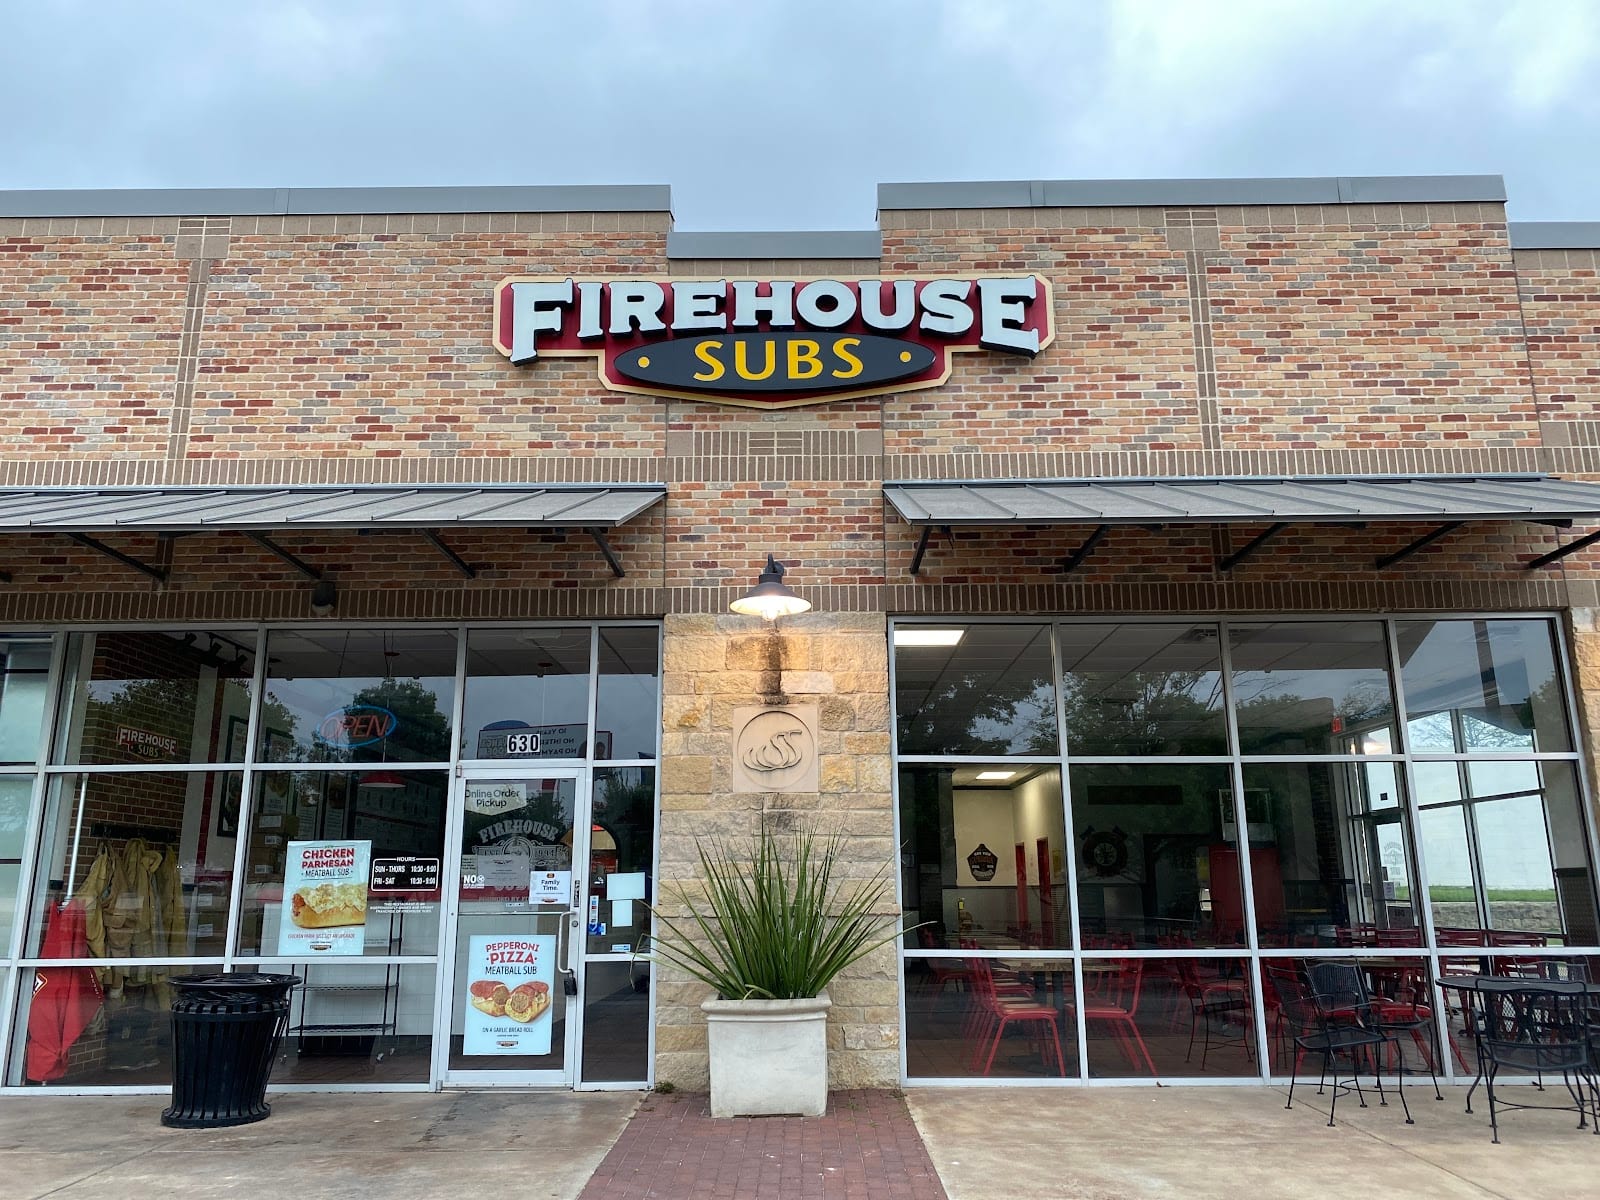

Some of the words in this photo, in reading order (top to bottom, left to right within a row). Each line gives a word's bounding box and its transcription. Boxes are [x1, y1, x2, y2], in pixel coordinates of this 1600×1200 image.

[508, 275, 1040, 363] FIREHOUSE
[693, 337, 864, 382] SUBS
[322, 715, 389, 738] OPEN
[119, 728, 177, 756] FIREHOUSE
[508, 735, 540, 752] 630
[138, 744, 159, 758] SUBS
[465, 789, 492, 798] Online
[493, 789, 520, 798] Order
[476, 800, 507, 808] Pickup
[479, 819, 559, 843] FIREHOUSE
[303, 848, 355, 859] CHICKEN
[302, 859, 354, 869] PARMESAN
[305, 869, 336, 877] MEATBALL
[338, 868, 350, 876] SUB
[385, 877, 395, 885] SAT
[463, 875, 477, 884] NO
[486, 941, 540, 952] PEPPERONI
[490, 951, 534, 965] PIZZA
[485, 966, 521, 975] MEATBALL
[523, 966, 538, 974] SUB
